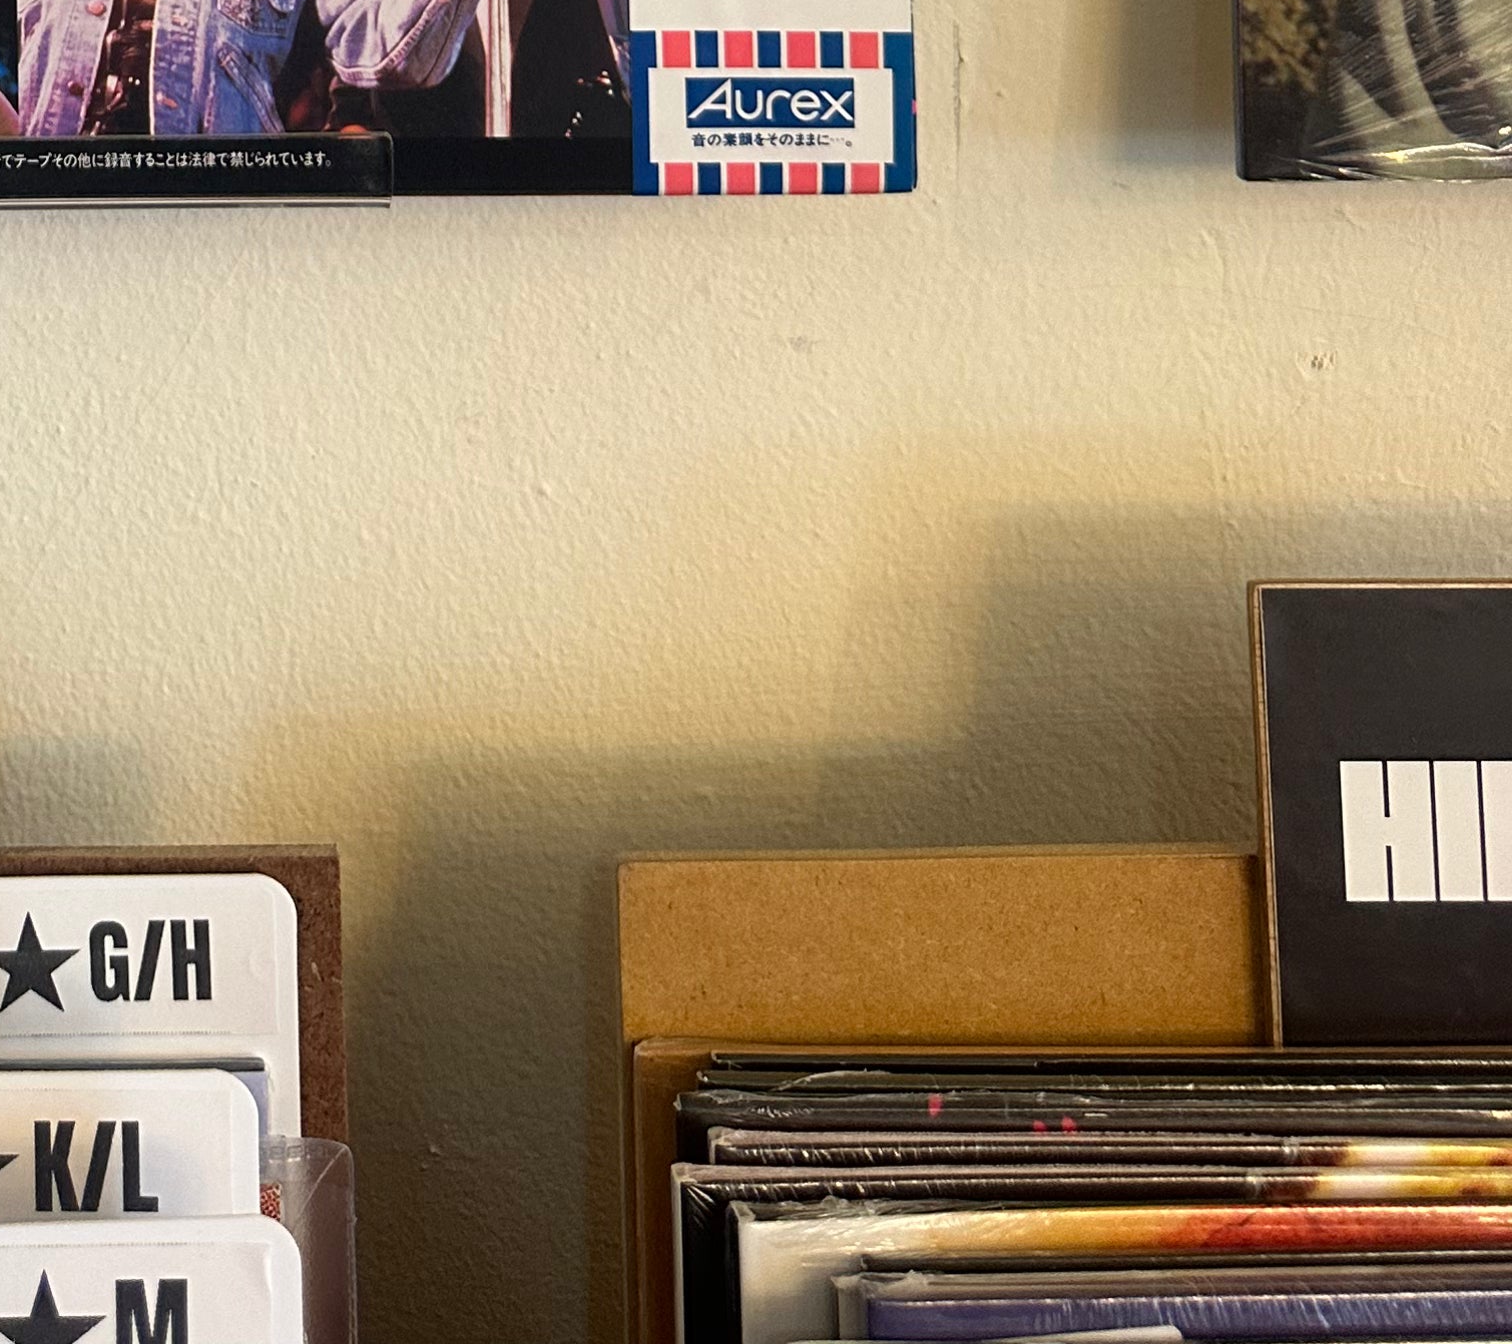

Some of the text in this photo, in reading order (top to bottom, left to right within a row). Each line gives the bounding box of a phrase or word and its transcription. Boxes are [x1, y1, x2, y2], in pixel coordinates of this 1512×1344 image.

[688, 78, 854, 121] Aurex
[89, 918, 213, 1002] G/H
[33, 1120, 159, 1212] K/L
[115, 1278, 188, 1344] M
